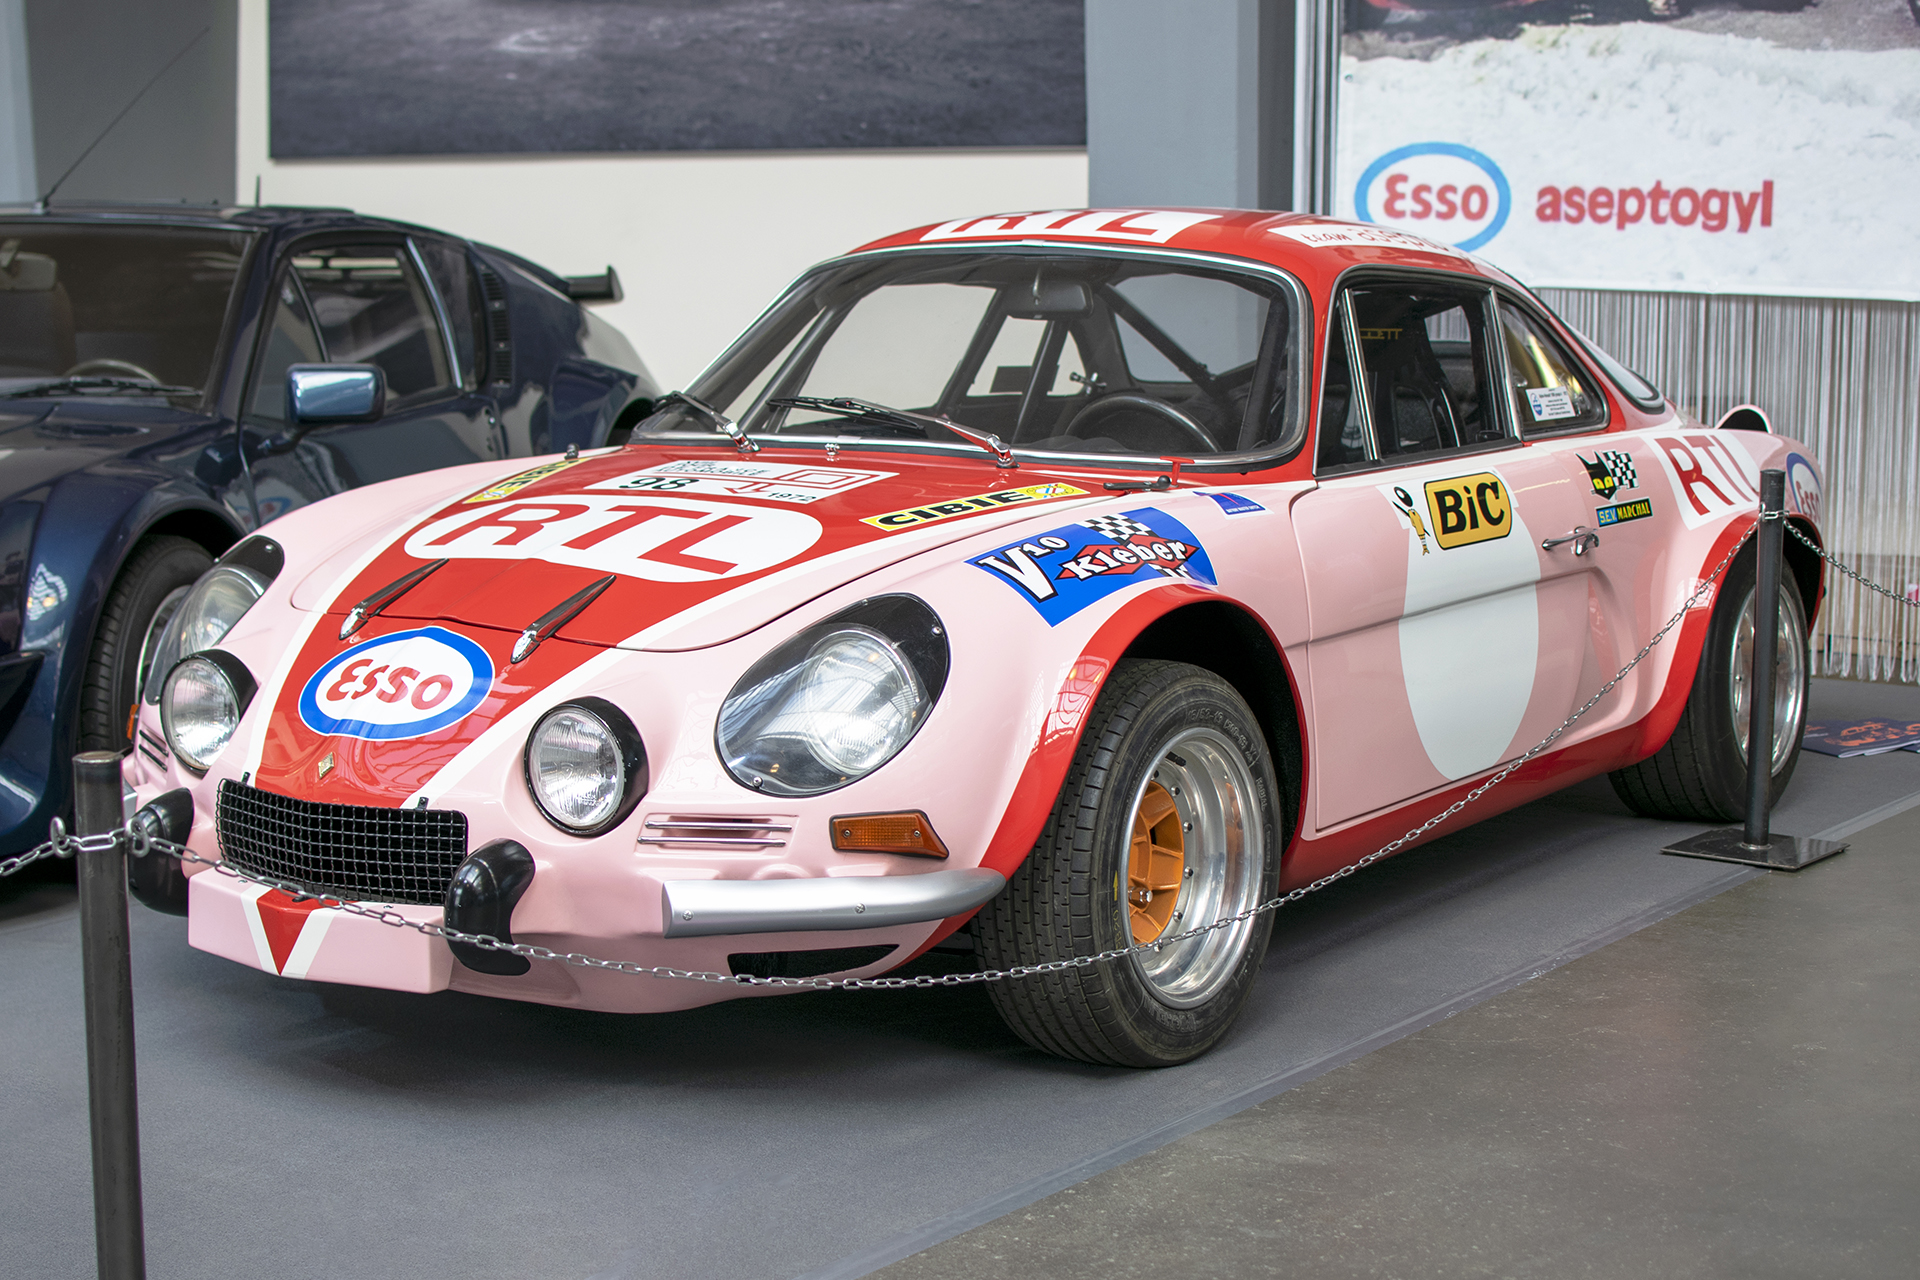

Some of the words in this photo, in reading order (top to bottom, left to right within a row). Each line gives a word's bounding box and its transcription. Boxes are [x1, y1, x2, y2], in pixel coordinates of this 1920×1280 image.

[1383, 173, 1488, 221] Esso
[1536, 180, 1774, 233] aseptogyl
[619, 477, 700, 490] 98
[768, 491, 817, 502] 1972
[877, 491, 1035, 526] CIBIE
[1433, 481, 1505, 535] BiC
[1617, 502, 1651, 520] MARCHAL
[423, 503, 754, 575] RTL
[1062, 539, 1190, 580] Kleber
